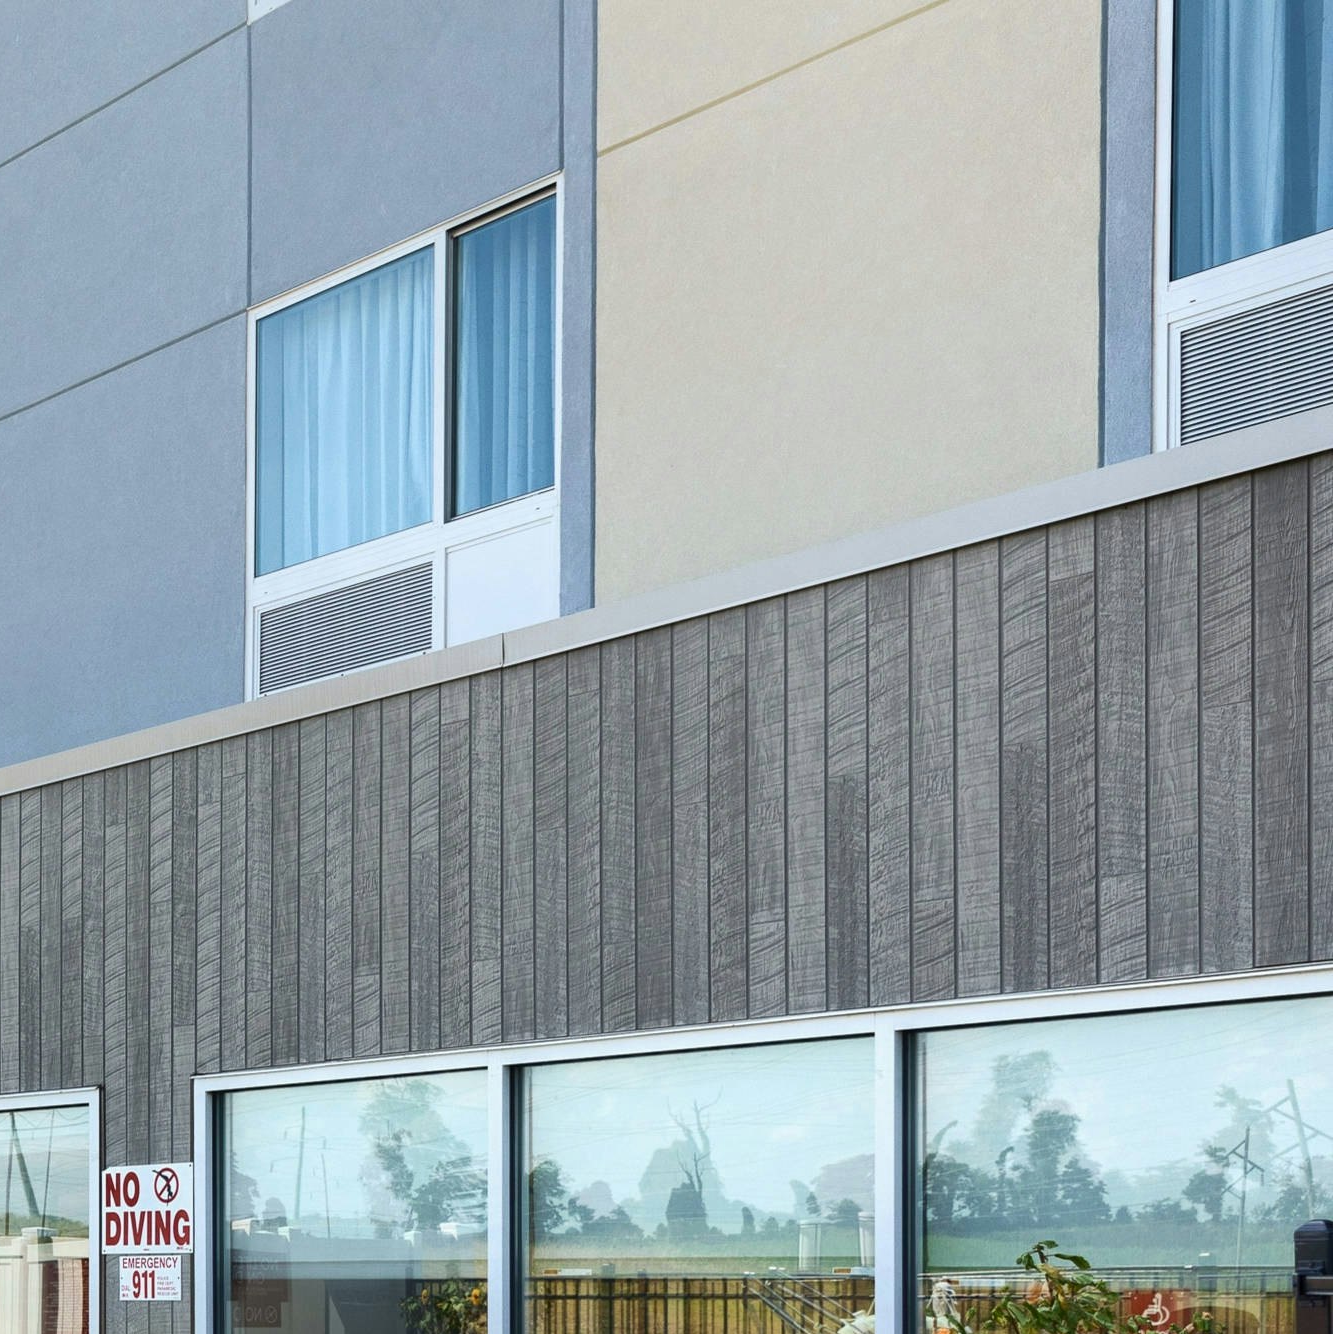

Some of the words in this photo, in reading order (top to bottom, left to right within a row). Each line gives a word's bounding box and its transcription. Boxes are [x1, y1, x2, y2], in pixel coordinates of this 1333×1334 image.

[105, 1171, 140, 1208] NO
[105, 1209, 191, 1246] DIVING
[122, 1257, 178, 1269] EMERGENCY
[132, 1270, 155, 1299] 911
